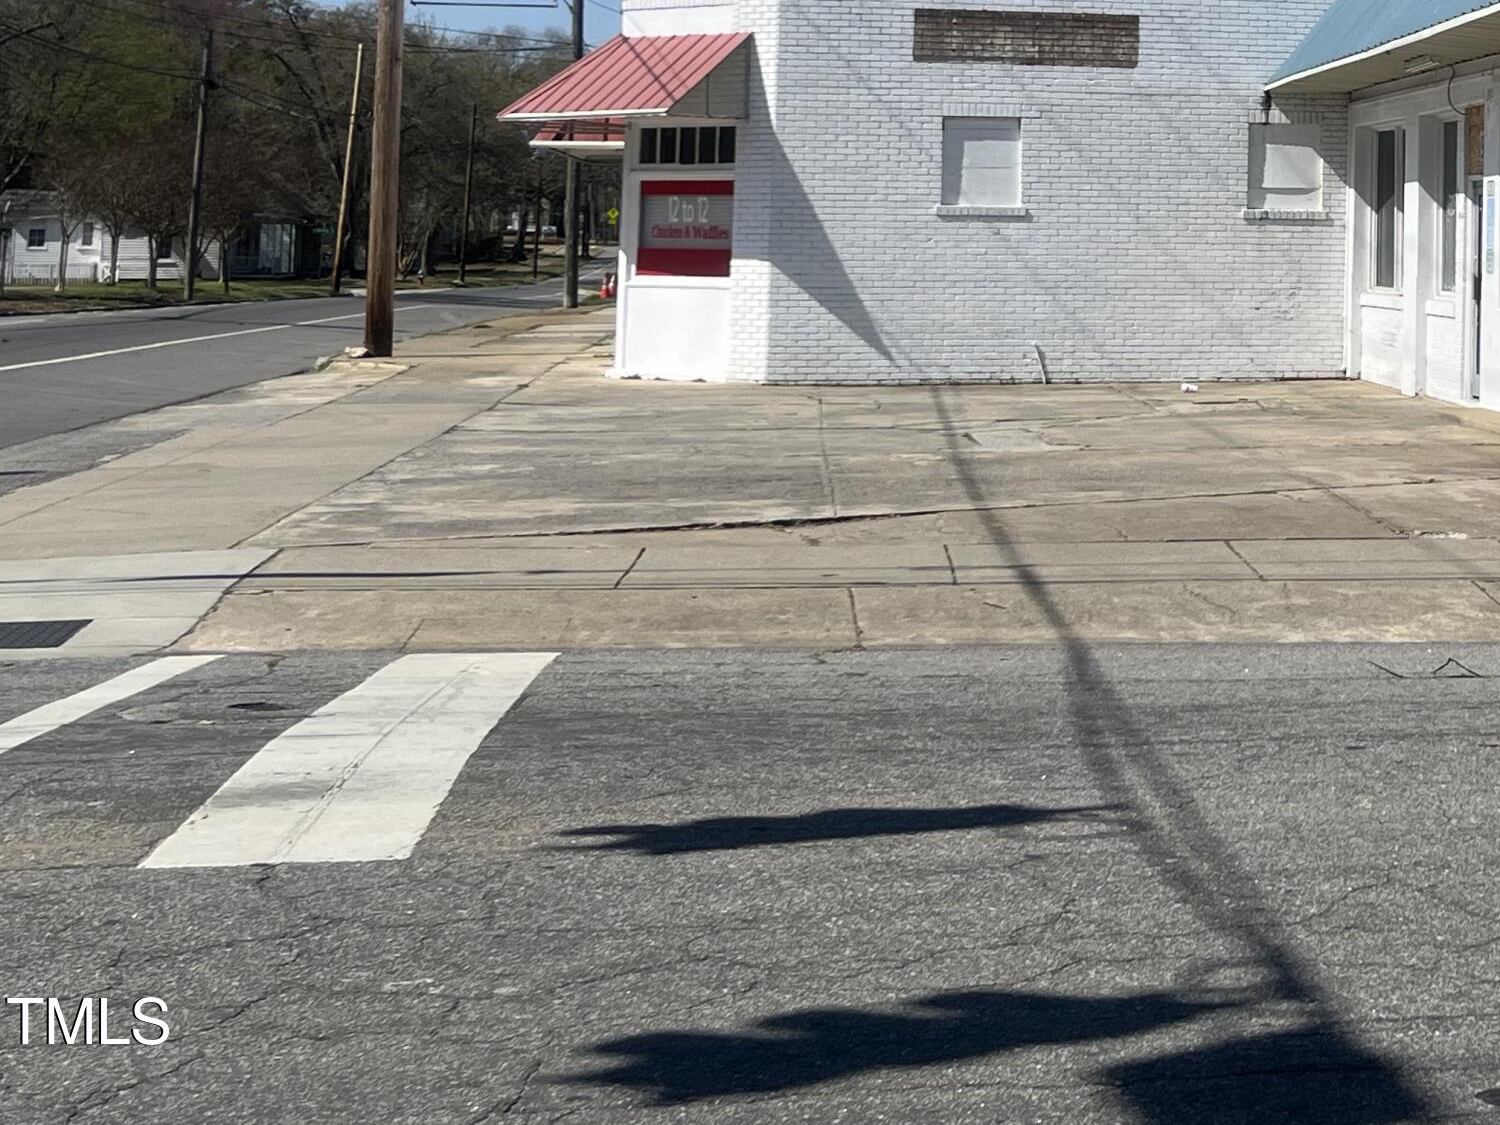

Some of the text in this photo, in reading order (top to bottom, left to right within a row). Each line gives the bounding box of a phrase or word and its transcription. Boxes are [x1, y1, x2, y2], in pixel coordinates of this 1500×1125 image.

[668, 196, 709, 223] 12 to 12
